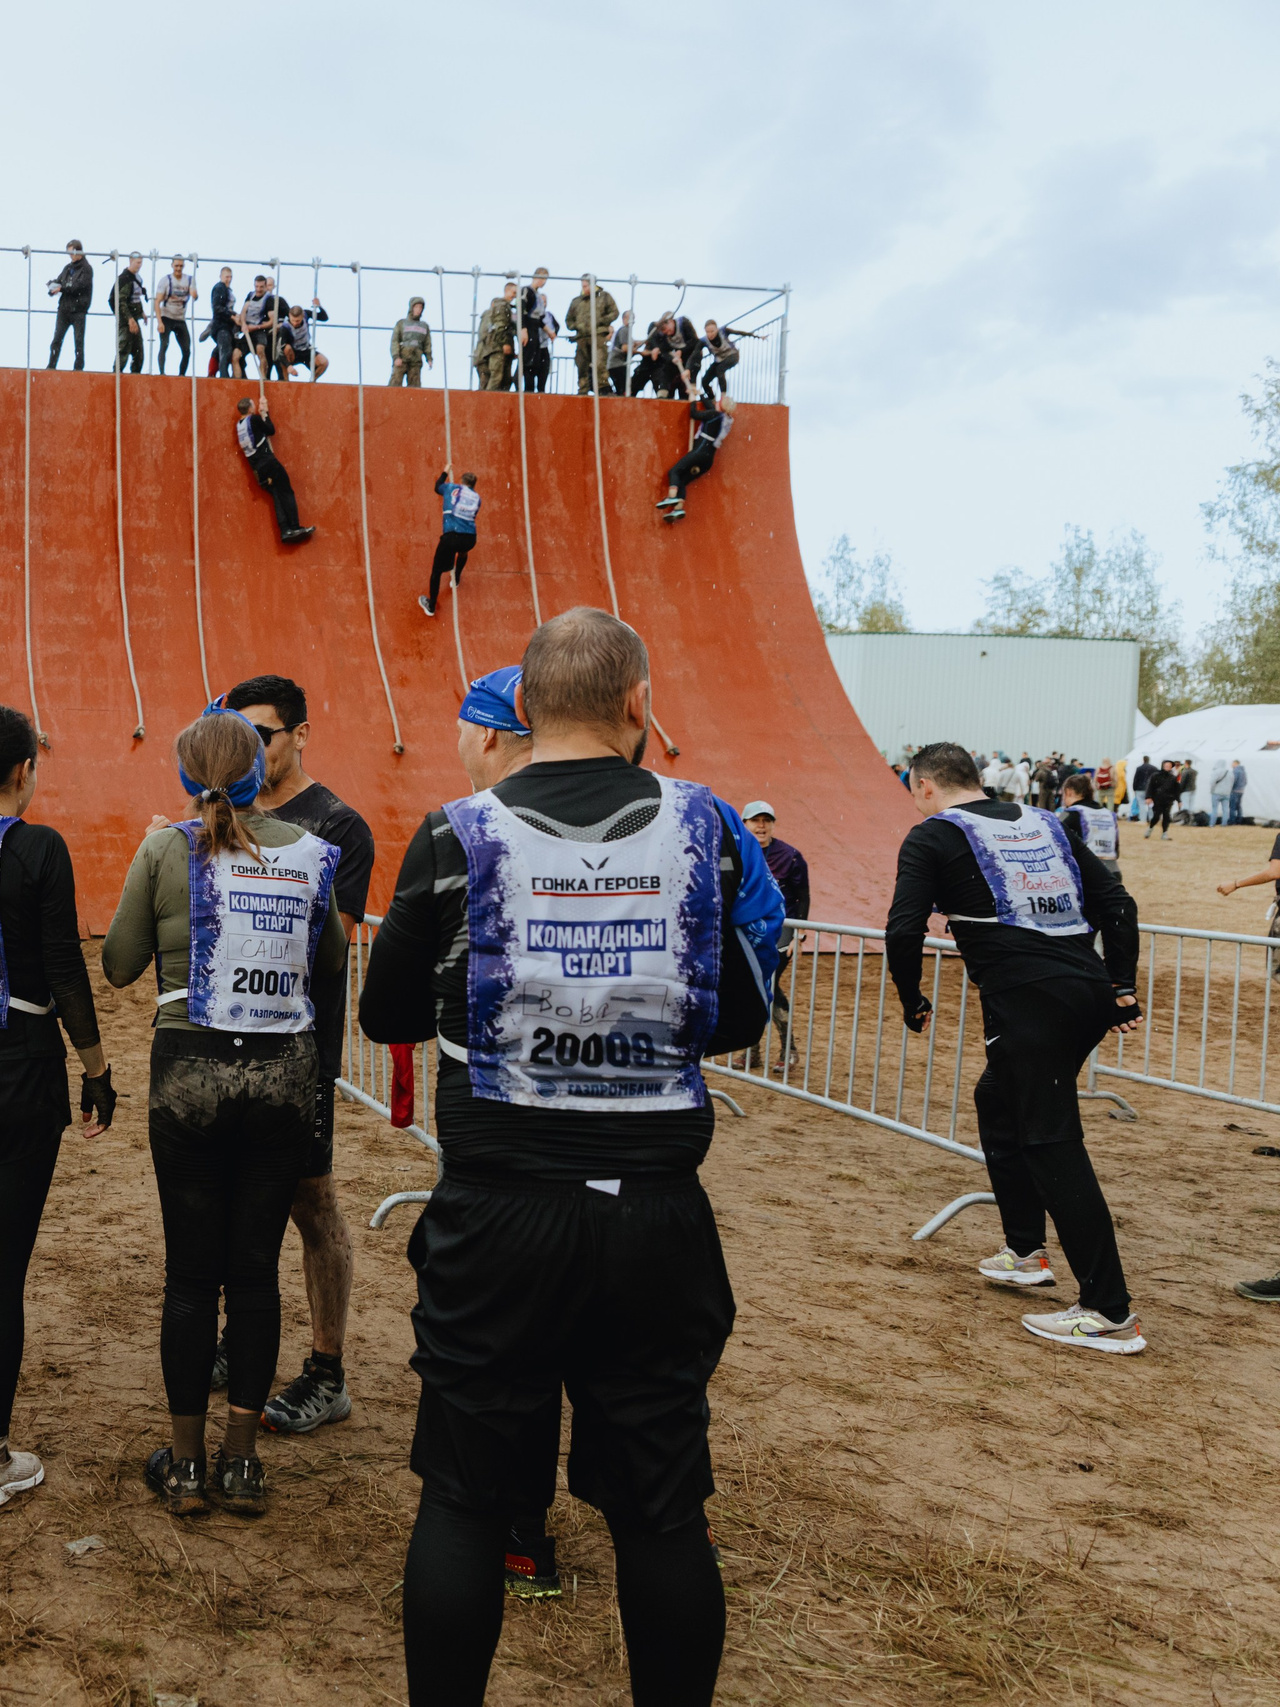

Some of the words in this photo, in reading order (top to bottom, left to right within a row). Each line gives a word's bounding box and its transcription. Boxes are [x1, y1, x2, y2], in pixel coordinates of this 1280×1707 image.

[1020, 829, 1043, 839] ГРОЕВ
[231, 865, 269, 877] ГОНКА
[271, 867, 309, 881] ГЕРОЕВ
[531, 876, 589, 892] ГОНКА
[594, 875, 661, 891] ГЕРОЕВ
[230, 894, 308, 918] КОМАНДНЫЙ
[1027, 893, 1072, 915] 16808
[255, 913, 291, 932] СТАРТ
[529, 918, 665, 950] КОМАНДНЫЙ
[564, 952, 628, 976] СТАРТ
[232, 967, 299, 998] 20007
[249, 1008, 302, 1021] ГАЗПРОМБАНК
[529, 1026, 655, 1068] 20009
[566, 1081, 664, 1097] ГАЗПРОМБАНК
